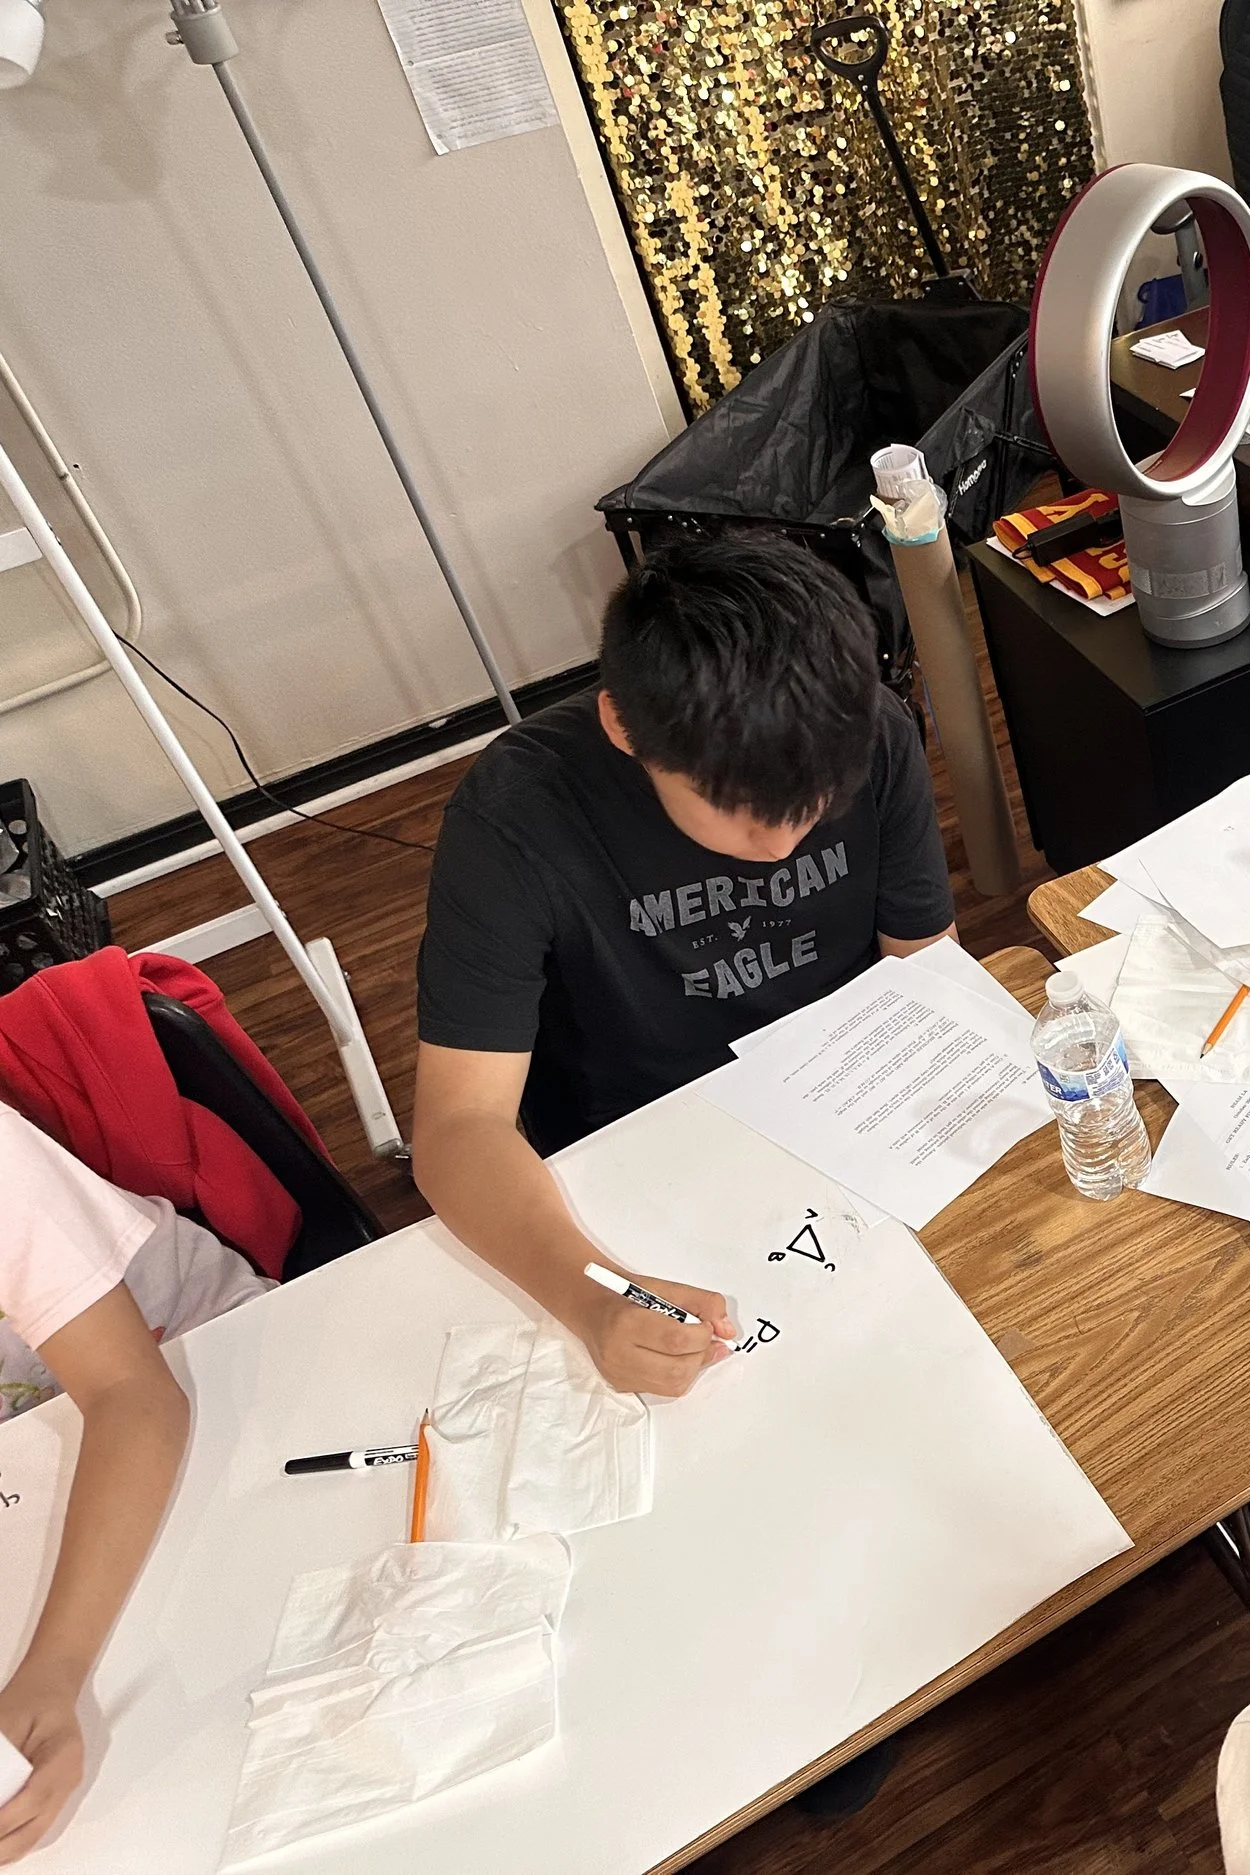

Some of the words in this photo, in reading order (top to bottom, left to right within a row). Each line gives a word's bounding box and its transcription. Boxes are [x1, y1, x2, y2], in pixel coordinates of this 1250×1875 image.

[629, 841, 849, 937] AMERICAN
[681, 930, 818, 999] EAGLE
[692, 935, 719, 950] EST.
[762, 919, 792, 929] 1977
